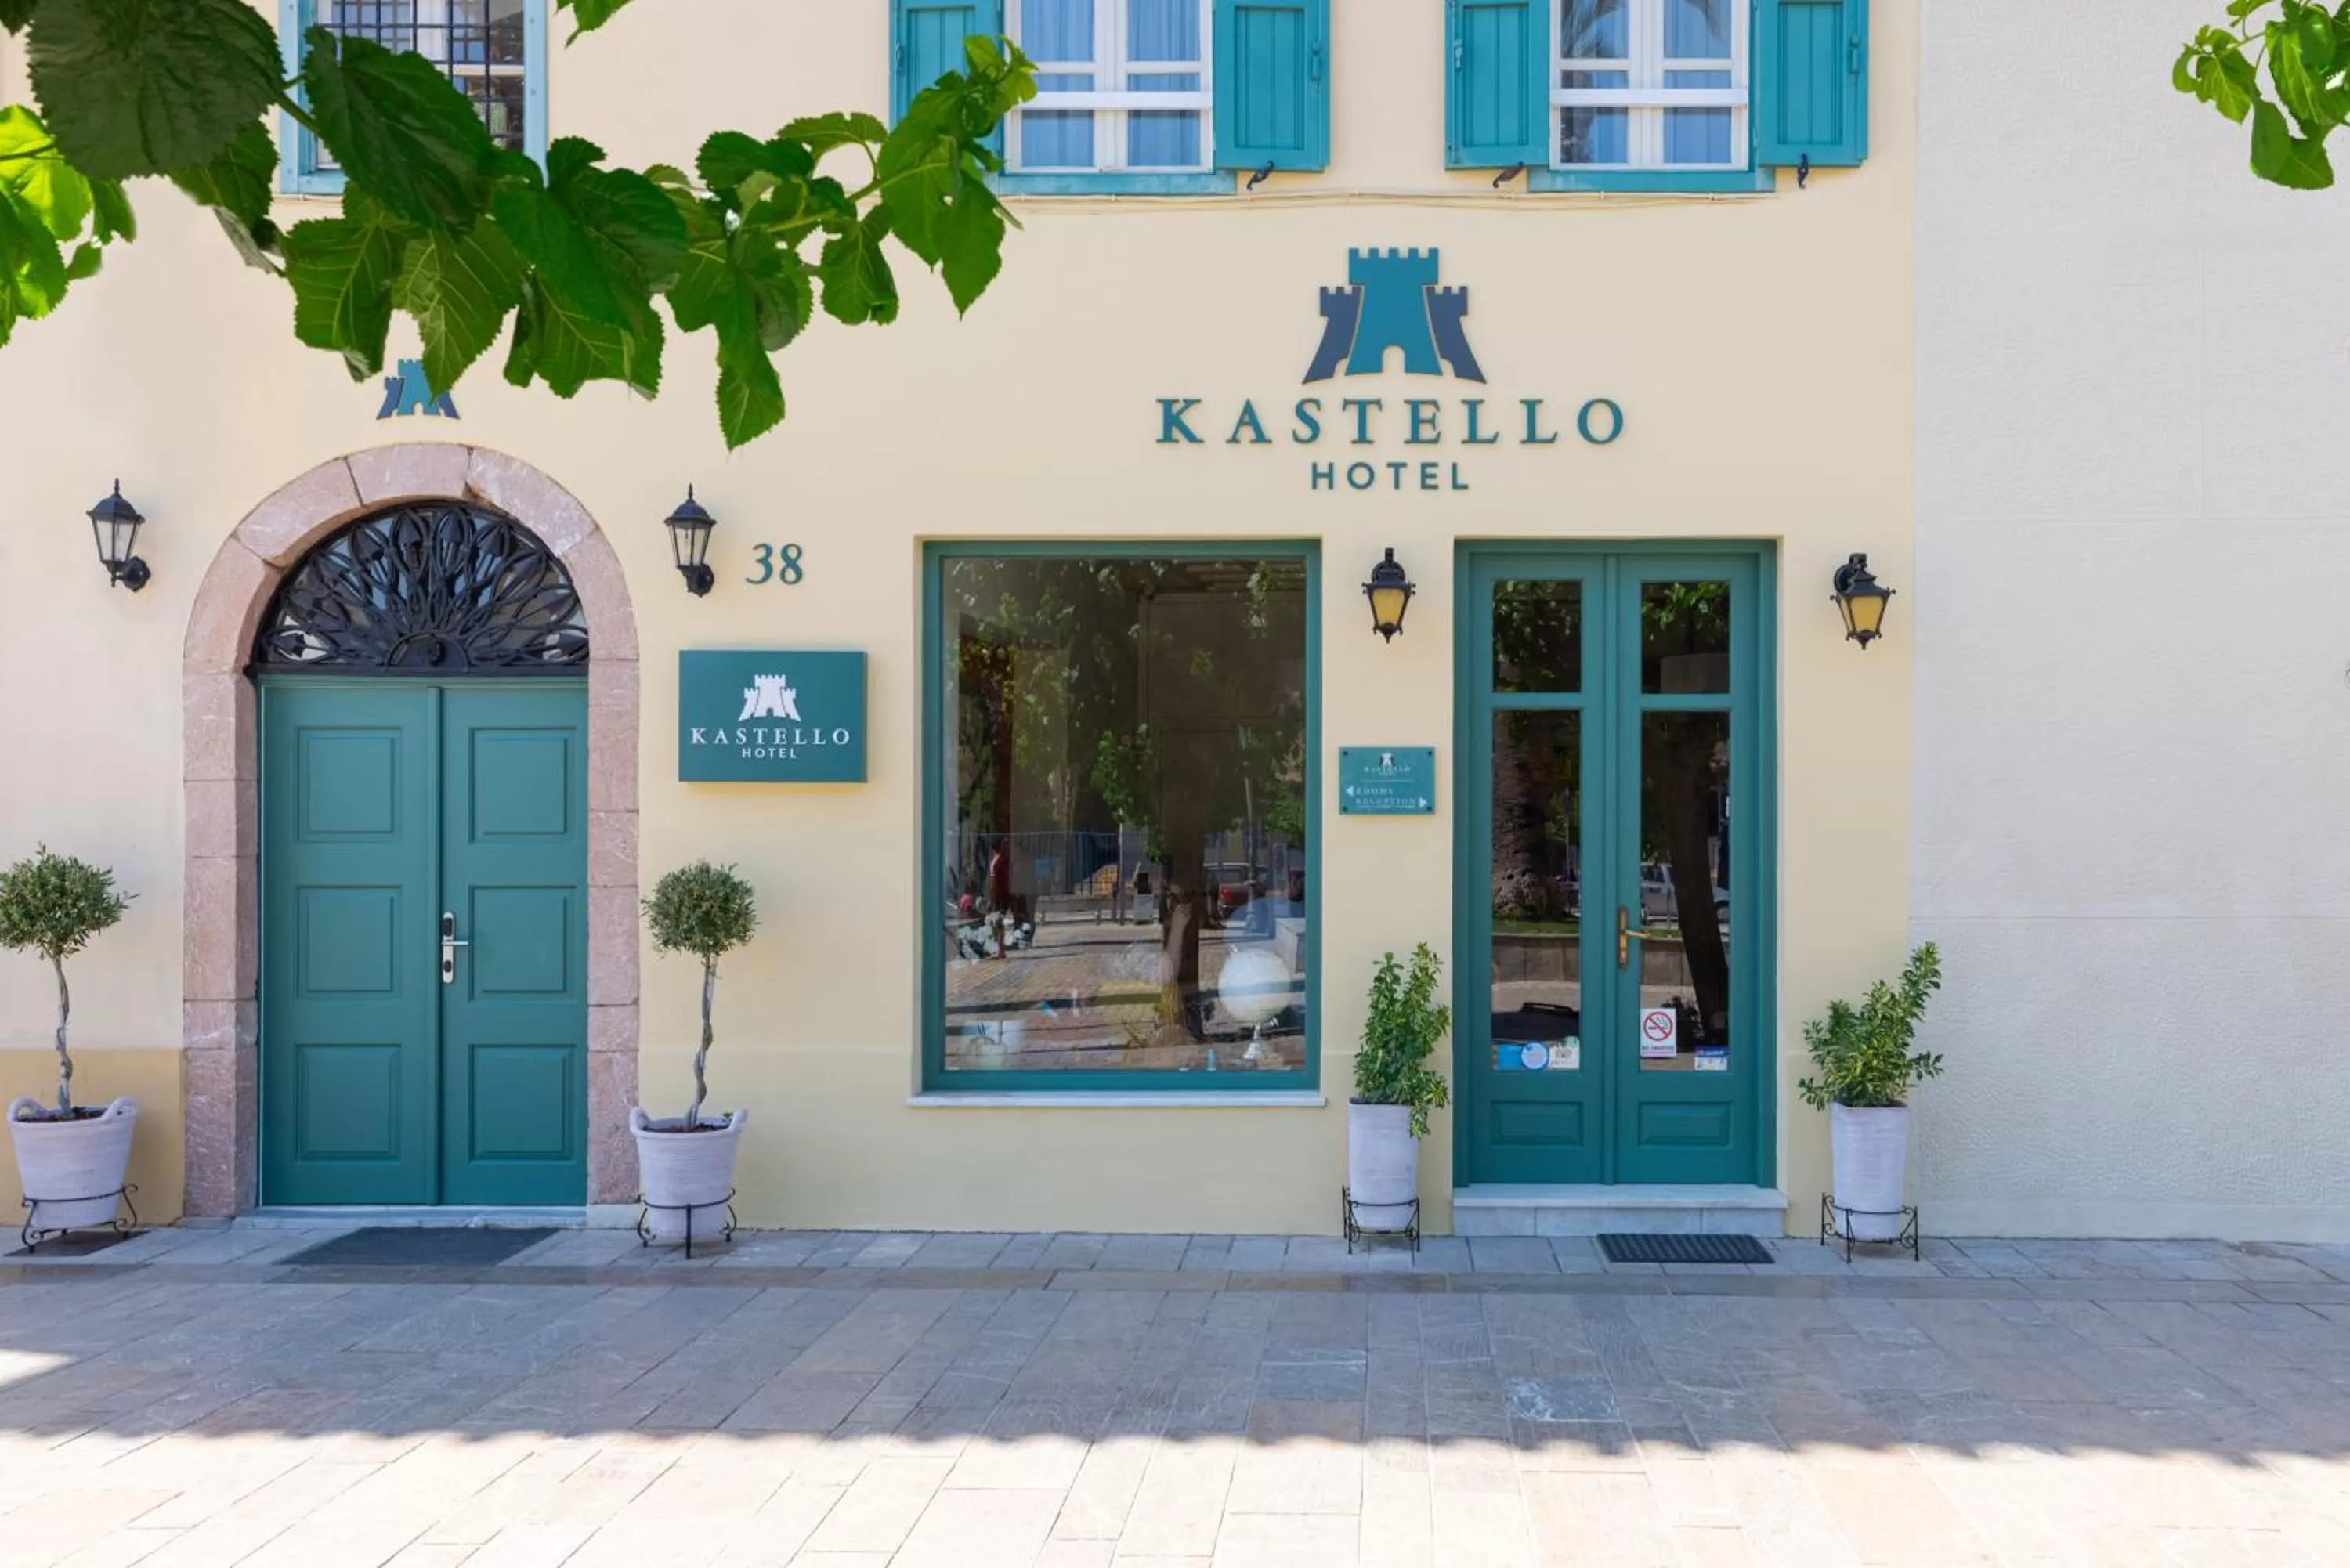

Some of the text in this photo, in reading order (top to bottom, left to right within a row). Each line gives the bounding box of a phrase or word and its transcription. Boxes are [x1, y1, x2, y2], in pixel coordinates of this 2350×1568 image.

[1155, 398, 1625, 446] KASTELLO
[1311, 461, 1470, 490] HOTEL
[745, 542, 804, 585] 38
[690, 727, 851, 746] KASTELLO
[742, 747, 797, 760] HOTEL
